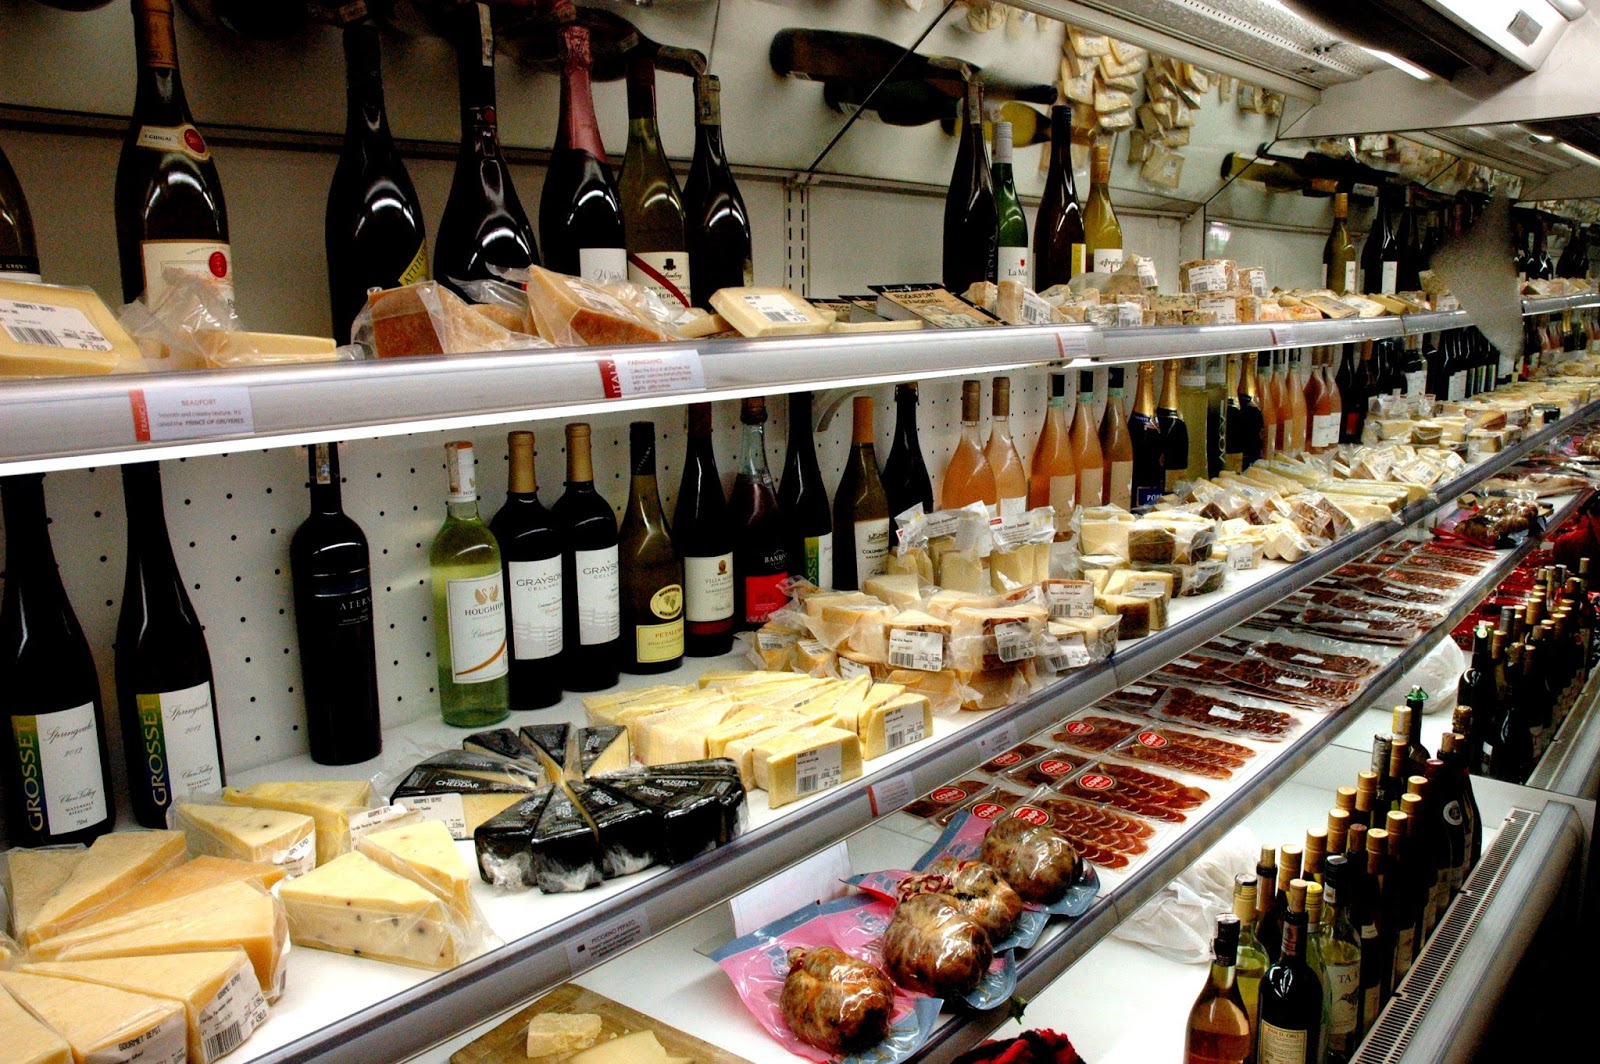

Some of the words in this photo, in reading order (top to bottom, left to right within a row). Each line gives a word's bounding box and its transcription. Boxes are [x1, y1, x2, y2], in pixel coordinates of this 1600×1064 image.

[404, 247, 427, 286] ATTITU
[988, 234, 996, 278] ROICA
[607, 360, 622, 394] ITALY
[181, 399, 217, 407] BEAUFORT
[185, 418, 206, 426] PRINCE
[207, 418, 215, 426] OF
[43, 719, 95, 745] Springvale
[142, 701, 168, 806] GROSSET
[17, 725, 44, 831] GROSSET
[435, 780, 479, 789] CHEDDAR
[118, 1036, 144, 1052] GOURMET
[146, 1025, 161, 1040] DEPOT
